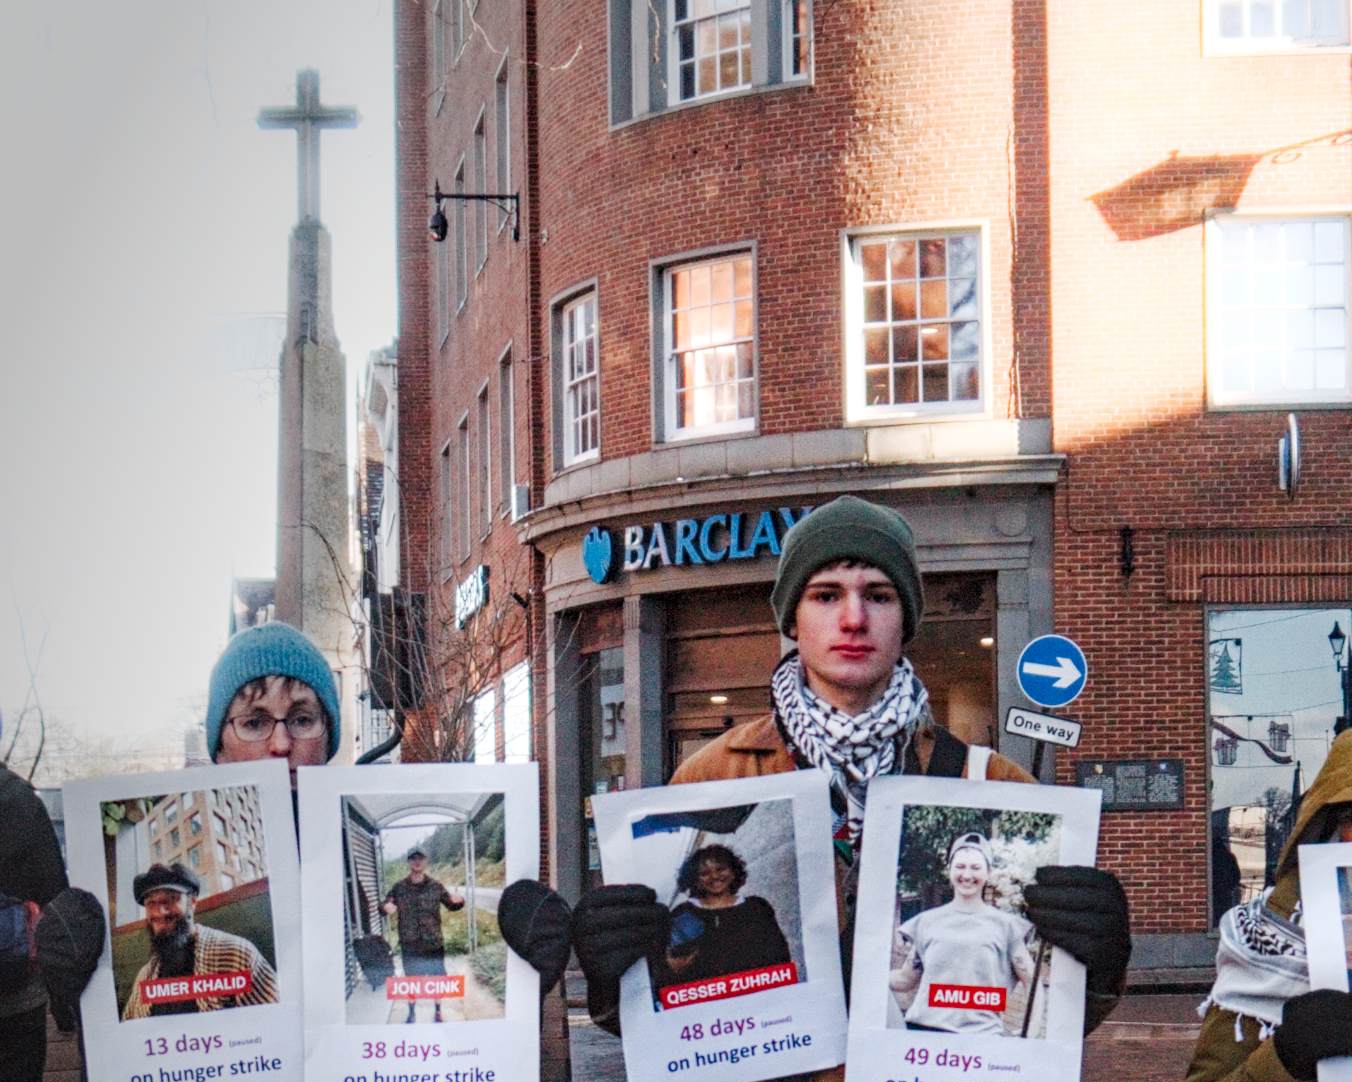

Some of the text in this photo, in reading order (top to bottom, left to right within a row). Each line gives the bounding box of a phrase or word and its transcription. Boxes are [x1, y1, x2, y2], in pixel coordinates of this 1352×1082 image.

[1013, 715, 1074, 741] One way
[145, 975, 247, 999] UMER KHALID
[392, 980, 460, 995] JON CINK
[666, 968, 792, 1005] QESSER ZUHRAH
[933, 989, 1001, 1006] AMU GIB
[680, 1025, 705, 1042] 48
[710, 1015, 756, 1037] days
[144, 1037, 169, 1057] 13
[175, 1033, 223, 1054] days
[361, 1041, 387, 1059] 38
[394, 1040, 441, 1062] days
[667, 1033, 812, 1073] on hunger strike
[159, 1063, 224, 1082] hunger
[230, 1056, 282, 1076] strike
[904, 1047, 929, 1065] 49
[935, 1049, 983, 1072] days
